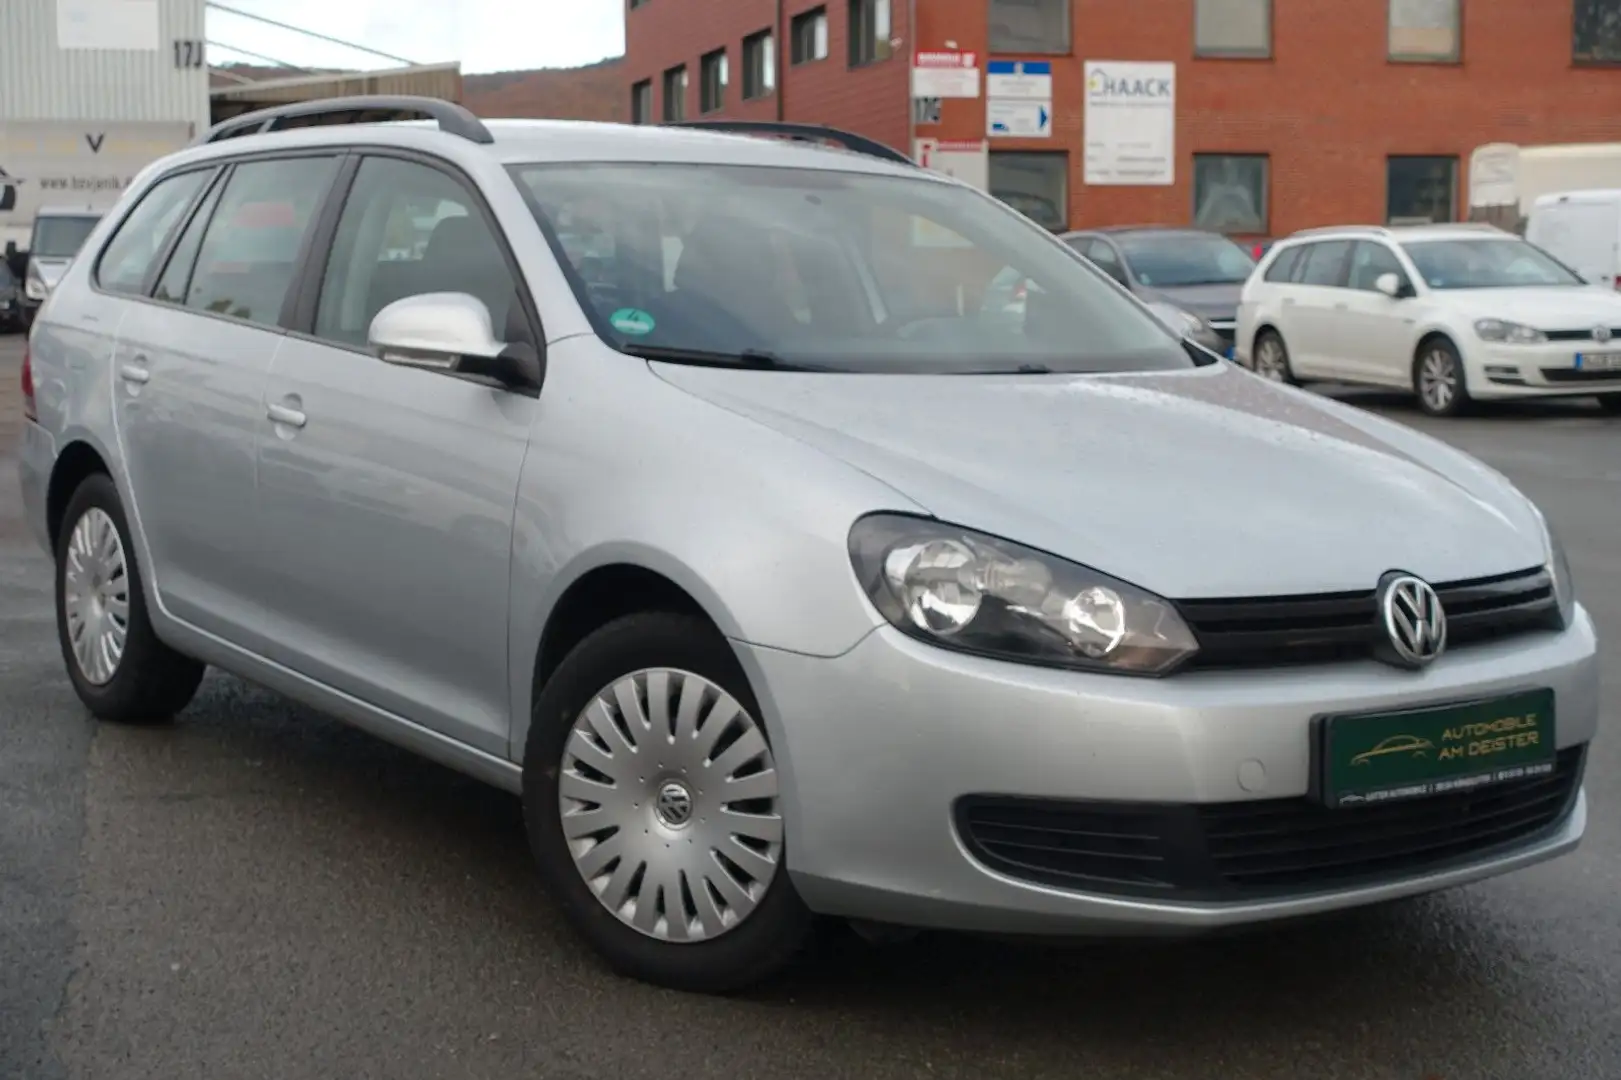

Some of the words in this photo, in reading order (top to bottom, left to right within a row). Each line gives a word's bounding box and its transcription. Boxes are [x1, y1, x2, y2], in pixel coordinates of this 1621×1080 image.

[1102, 77, 1171, 97] HAACK
[1441, 713, 1537, 741] AUTOMOBILE
[1438, 746, 1464, 761] AM
[1468, 731, 1539, 756] DEISTER
